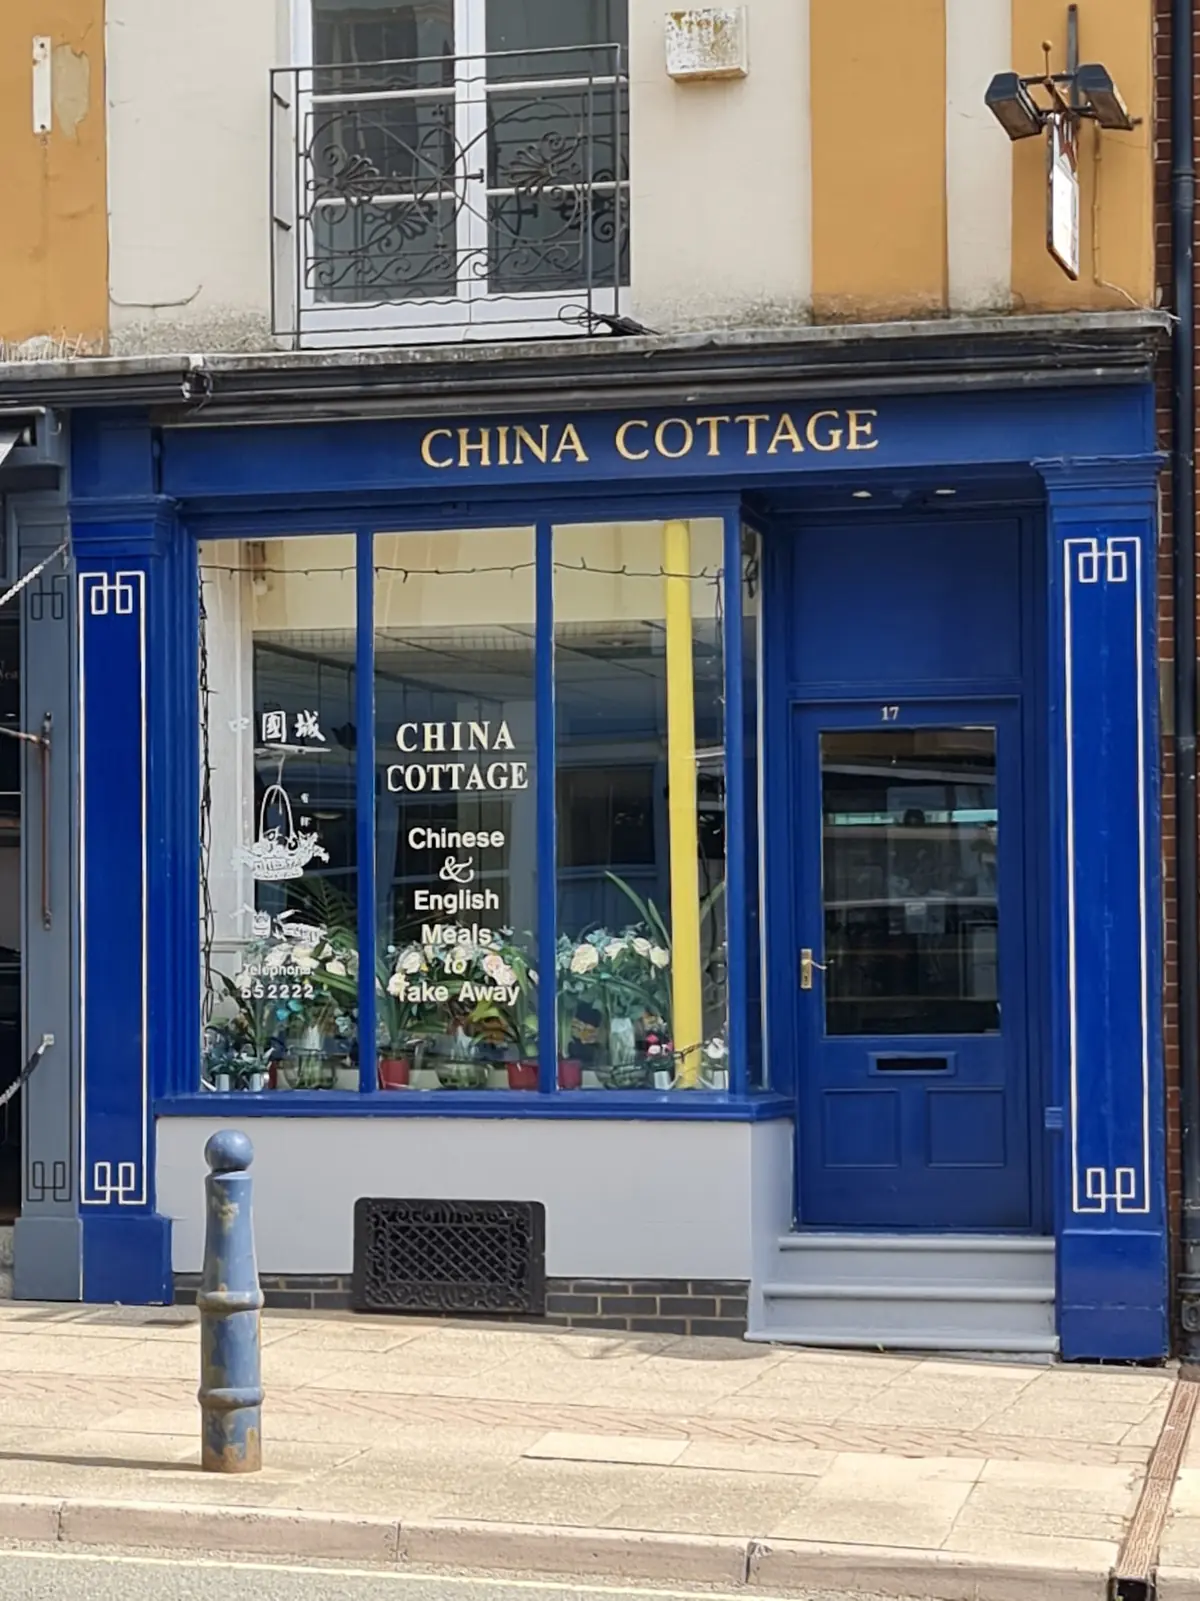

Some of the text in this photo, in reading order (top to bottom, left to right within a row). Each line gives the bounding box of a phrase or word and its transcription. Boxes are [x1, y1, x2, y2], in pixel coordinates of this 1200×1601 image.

[420, 409, 879, 468] CHINA COTTAGE
[881, 706, 900, 721] 17
[396, 720, 515, 752] CHINA
[386, 762, 529, 791] COTTAGE
[408, 827, 505, 850] Chinese
[439, 856, 474, 884] &
[414, 888, 500, 914] English
[421, 923, 492, 945] Meals
[444, 954, 467, 974] to
[458, 981, 520, 1006] Away
